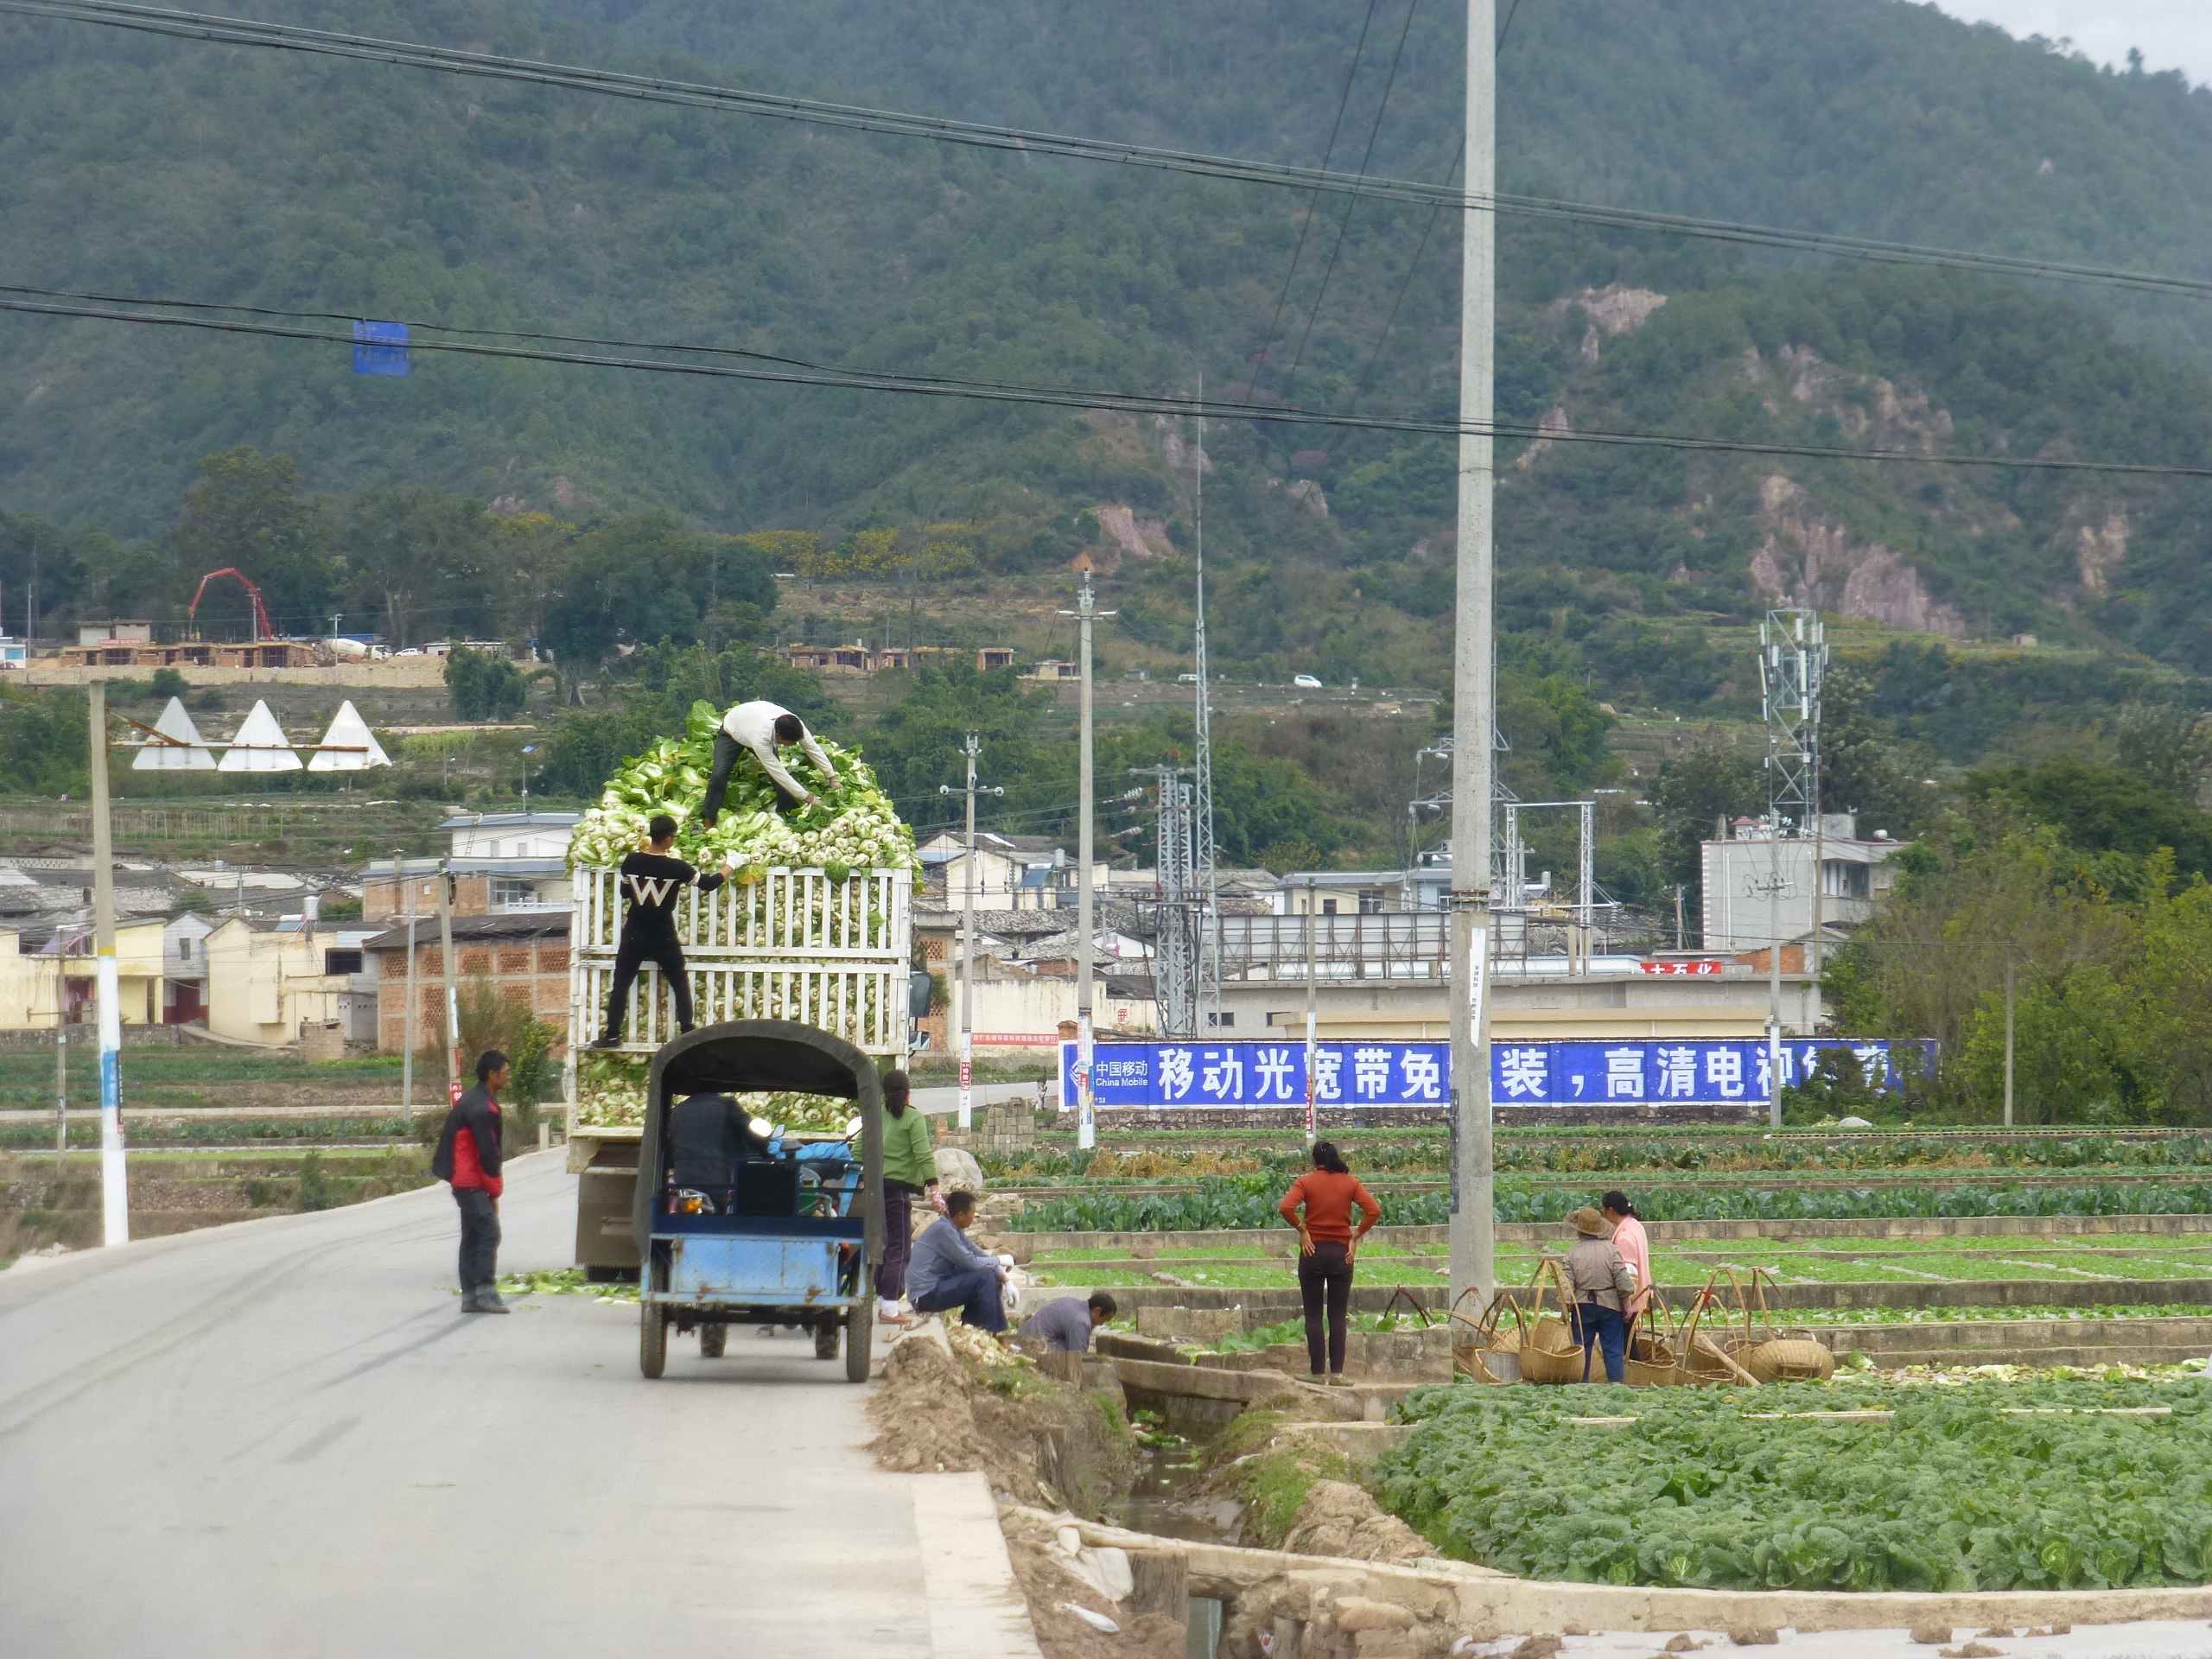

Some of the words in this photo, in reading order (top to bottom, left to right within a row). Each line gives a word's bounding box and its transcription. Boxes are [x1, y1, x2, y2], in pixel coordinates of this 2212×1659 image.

[626, 874, 679, 907] W
[1096, 1059, 1148, 1077] 中国移动
[1096, 1077, 1120, 1087] China
[1121, 1077, 1148, 1087] Mobile
